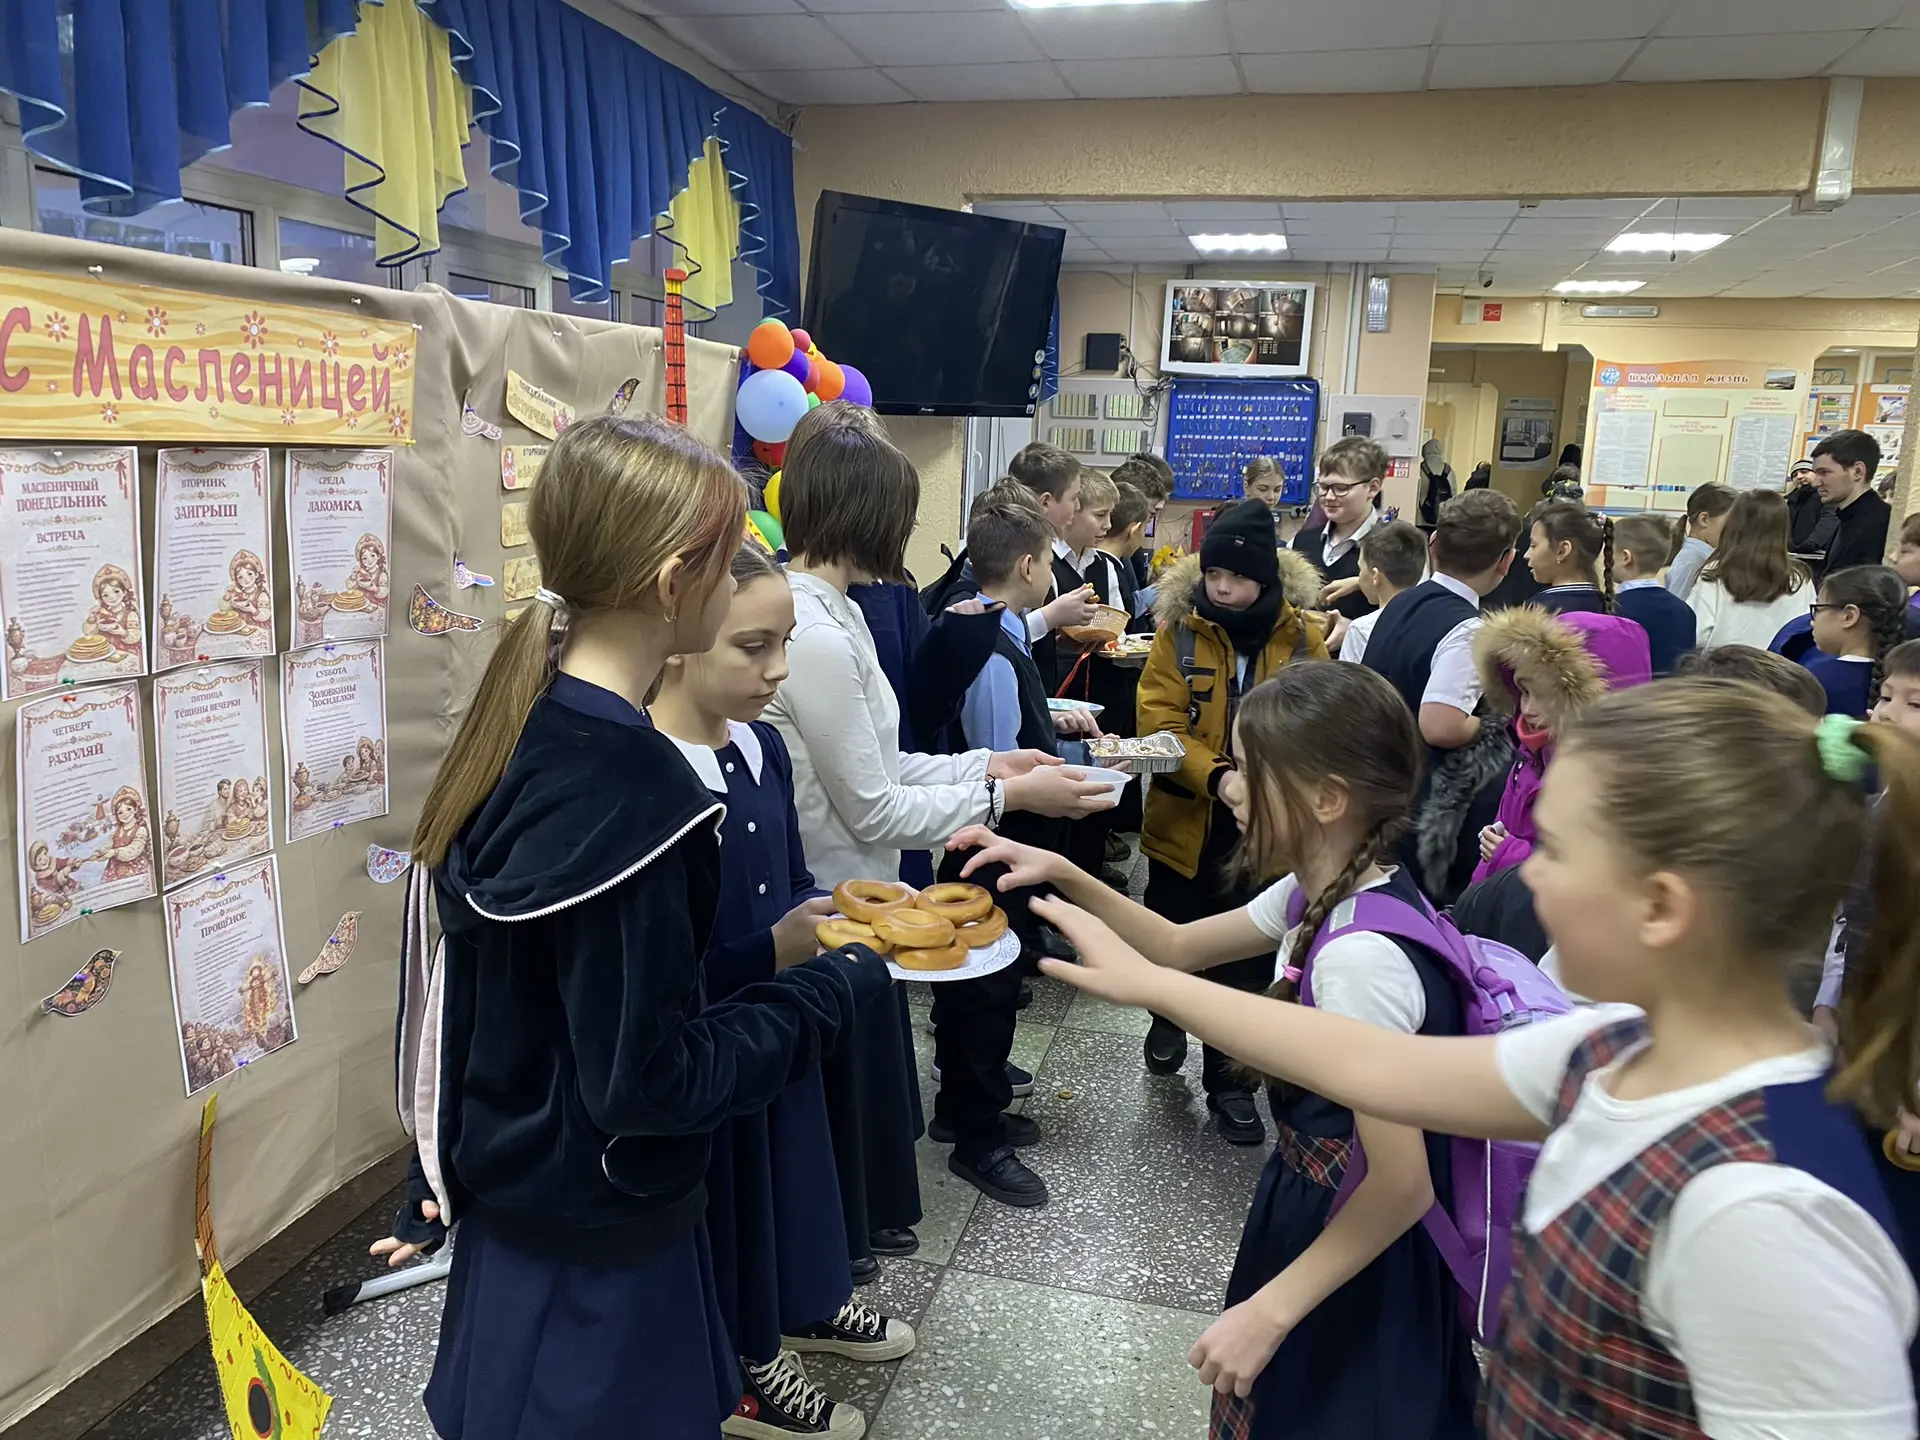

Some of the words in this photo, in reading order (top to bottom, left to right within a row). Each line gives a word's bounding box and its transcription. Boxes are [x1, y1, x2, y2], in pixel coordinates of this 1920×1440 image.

[0, 306, 31, 392] С
[73, 311, 391, 418] Масленицей
[1628, 372, 1699, 383] ШКОЛЬНАЯ
[1705, 373, 1749, 384] ЖИЗНЬ
[21, 477, 99, 494] МАСЛЕНИЧНЫЙ
[181, 478, 227, 488] ВТОРНИК
[319, 476, 346, 486] СРЕДА
[16, 495, 108, 512] ПОНЕДЕЛЬНИК
[174, 503, 238, 520] ЗАИГРЫШ
[307, 500, 363, 513] ЛАКОМКА
[36, 530, 86, 544] ВСТРЕЧА
[316, 667, 347, 678] СУББОТА
[191, 691, 223, 703] ПЯТНИЦА
[309, 684, 357, 701] ЗОЛОВКИНЫ
[311, 693, 355, 708] ПОСИДЕЛКИ
[210, 699, 241, 712] ВЕЧЕРКИ
[52, 720, 94, 737] ЧЕТВЕРГ
[48, 743, 104, 767] РАЗГУЛЯЙ
[200, 893, 243, 915] ВОСКРЕСЕНЬЕ
[200, 911, 247, 938] ПРОЩЁНОЕ
